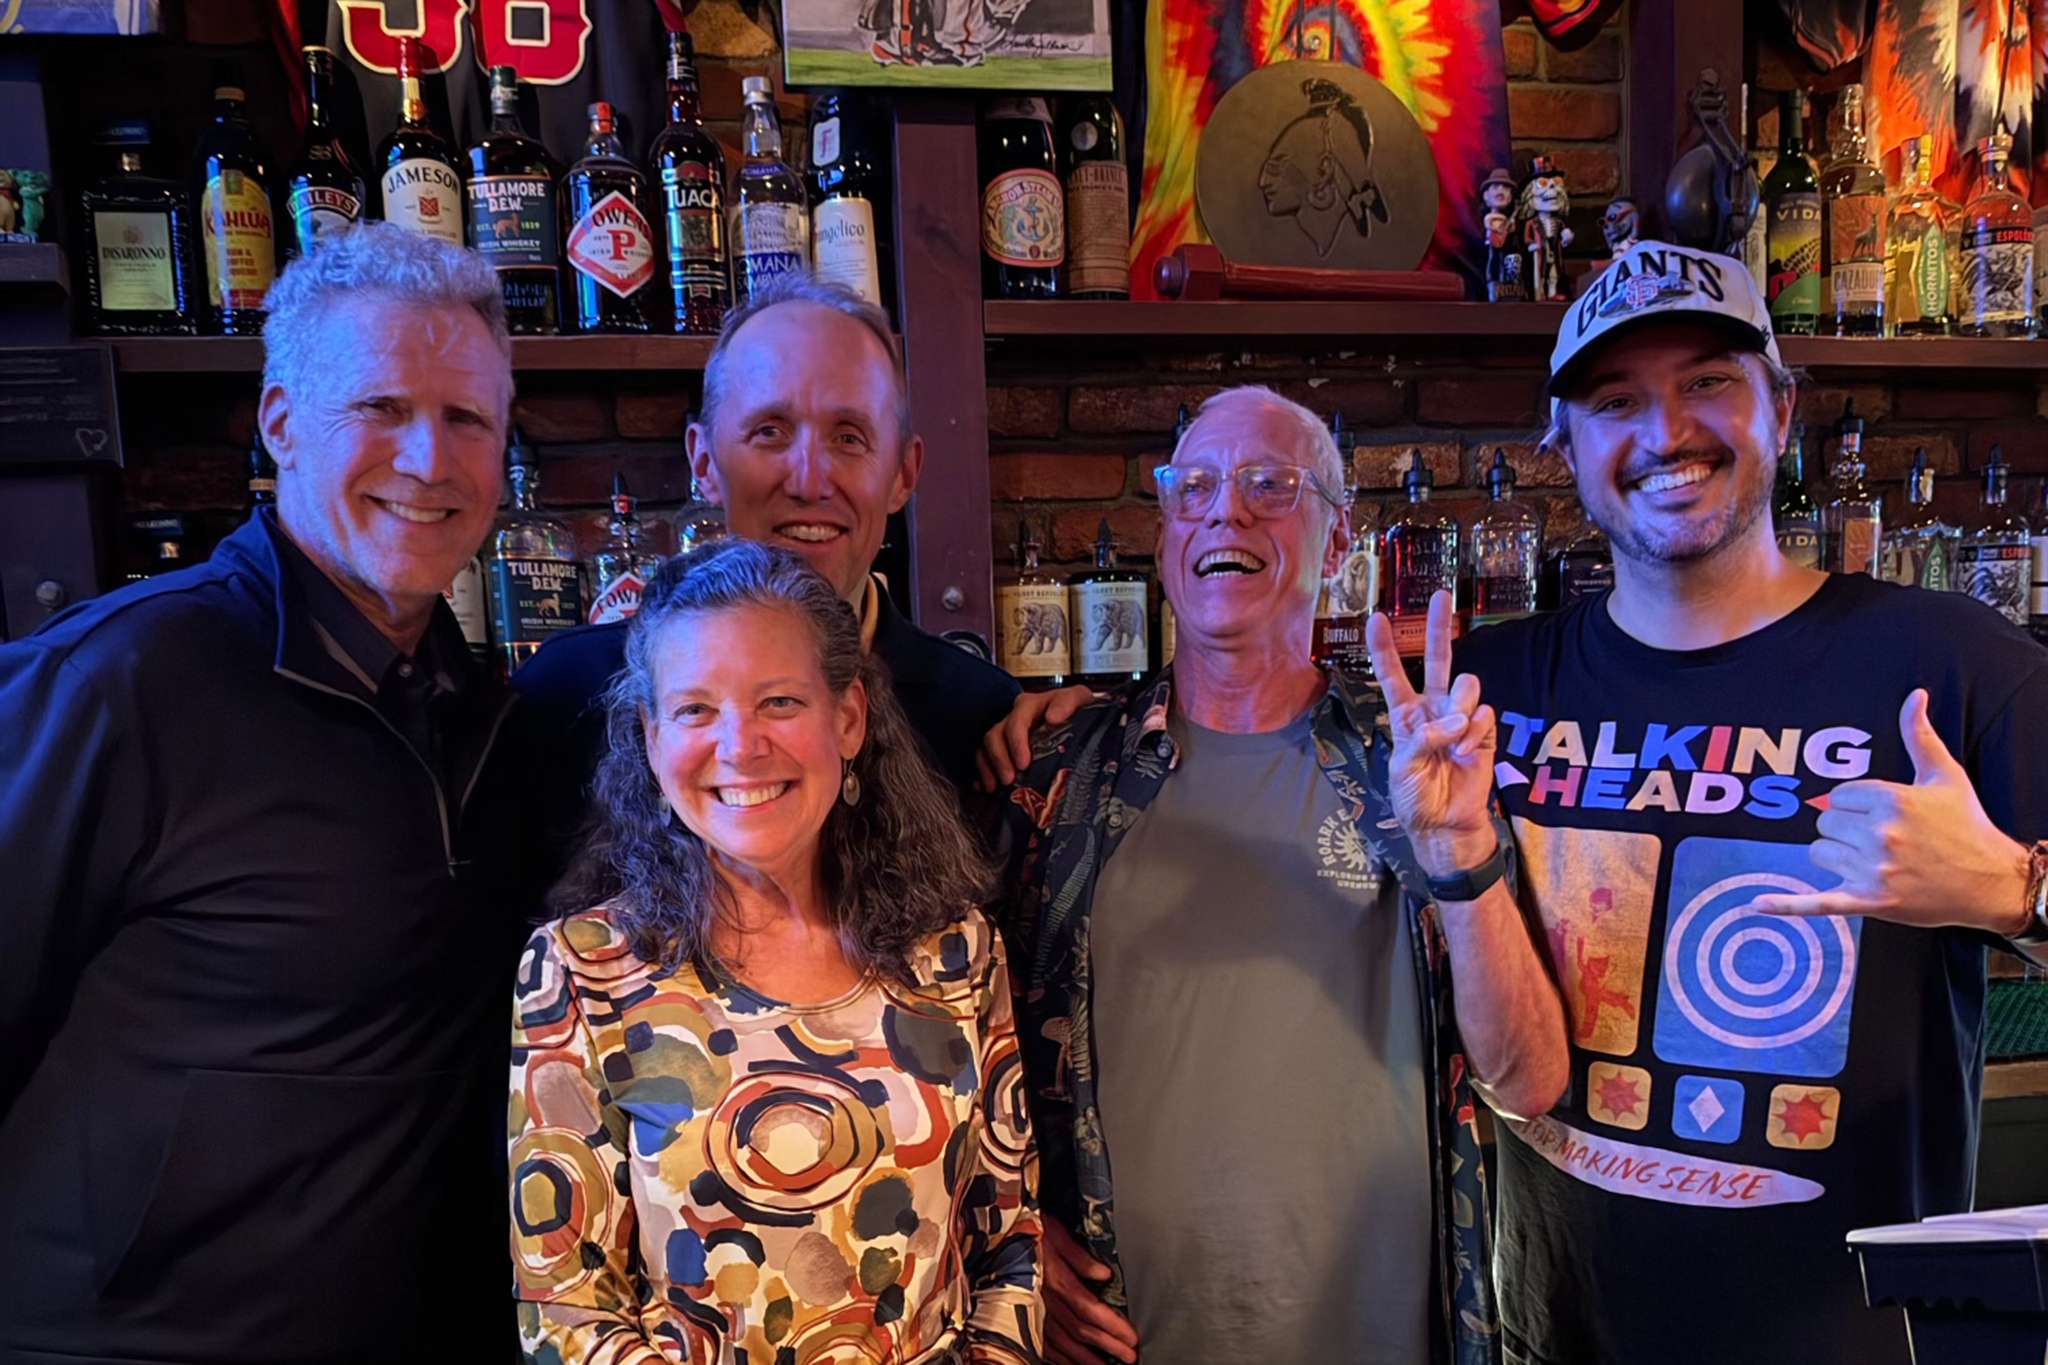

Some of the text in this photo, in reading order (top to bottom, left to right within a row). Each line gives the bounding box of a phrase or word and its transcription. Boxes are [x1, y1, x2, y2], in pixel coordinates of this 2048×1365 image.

[388, 167, 459, 196] JAMESON
[467, 182, 545, 199] TULLAMORE
[1777, 209, 1821, 220] VIDA
[102, 247, 166, 261] DISARONNO
[606, 228, 638, 262] P
[1926, 238, 1939, 312] HORNITOS
[1577, 250, 1725, 338] GIANTS
[507, 561, 577, 579] TULLAMORE
[1323, 627, 1359, 645] BUFFALO
[1501, 711, 1873, 780] TALKING
[1528, 765, 1802, 819] HEADS
[1338, 880, 1379, 890] UNKNOW
[1556, 1137, 1661, 1184] MAKING
[1658, 1166, 1774, 1200] SENSE
